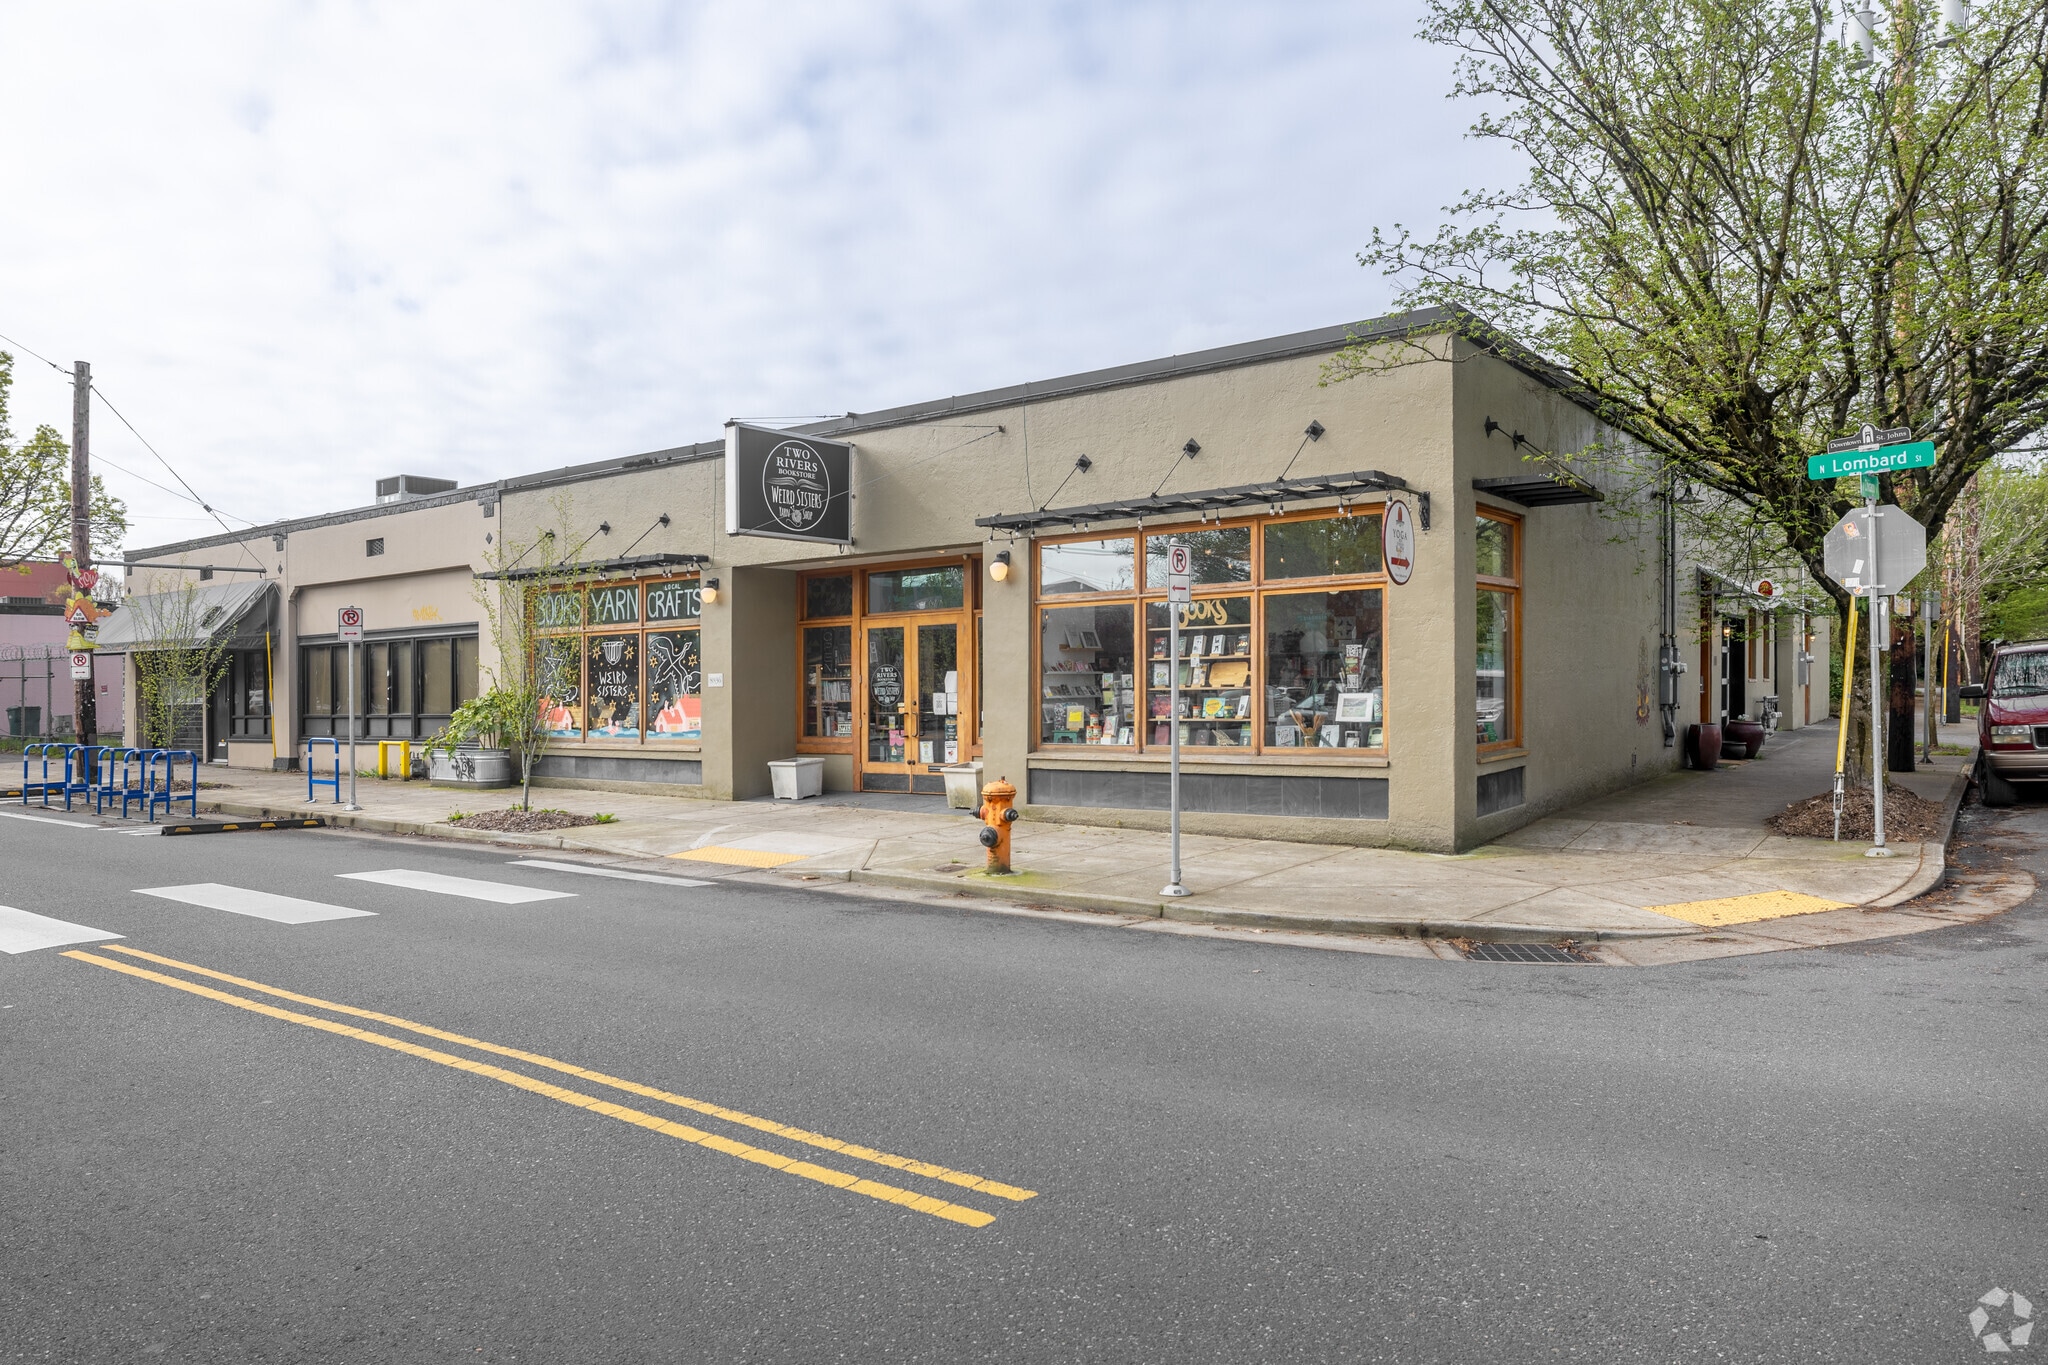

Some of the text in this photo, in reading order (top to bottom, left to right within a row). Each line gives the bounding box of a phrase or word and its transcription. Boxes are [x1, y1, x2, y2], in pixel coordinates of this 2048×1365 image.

[1830, 431, 1907, 449] Downtown St. Johns
[784, 447, 810, 459] TWO
[776, 456, 818, 472] RIVERS
[1819, 450, 1922, 474] N Lombard St
[778, 467, 816, 480] BOOKSTORE
[771, 485, 795, 505] WEIRD
[1392, 528, 1408, 541] YOGA
[78, 571, 97, 589] SLOW
[664, 582, 681, 591] LOCAL
[538, 587, 701, 626] BOOKS YARN CRAFTS
[598, 670, 628, 685] WEIRD
[596, 685, 628, 697] SISTERS
